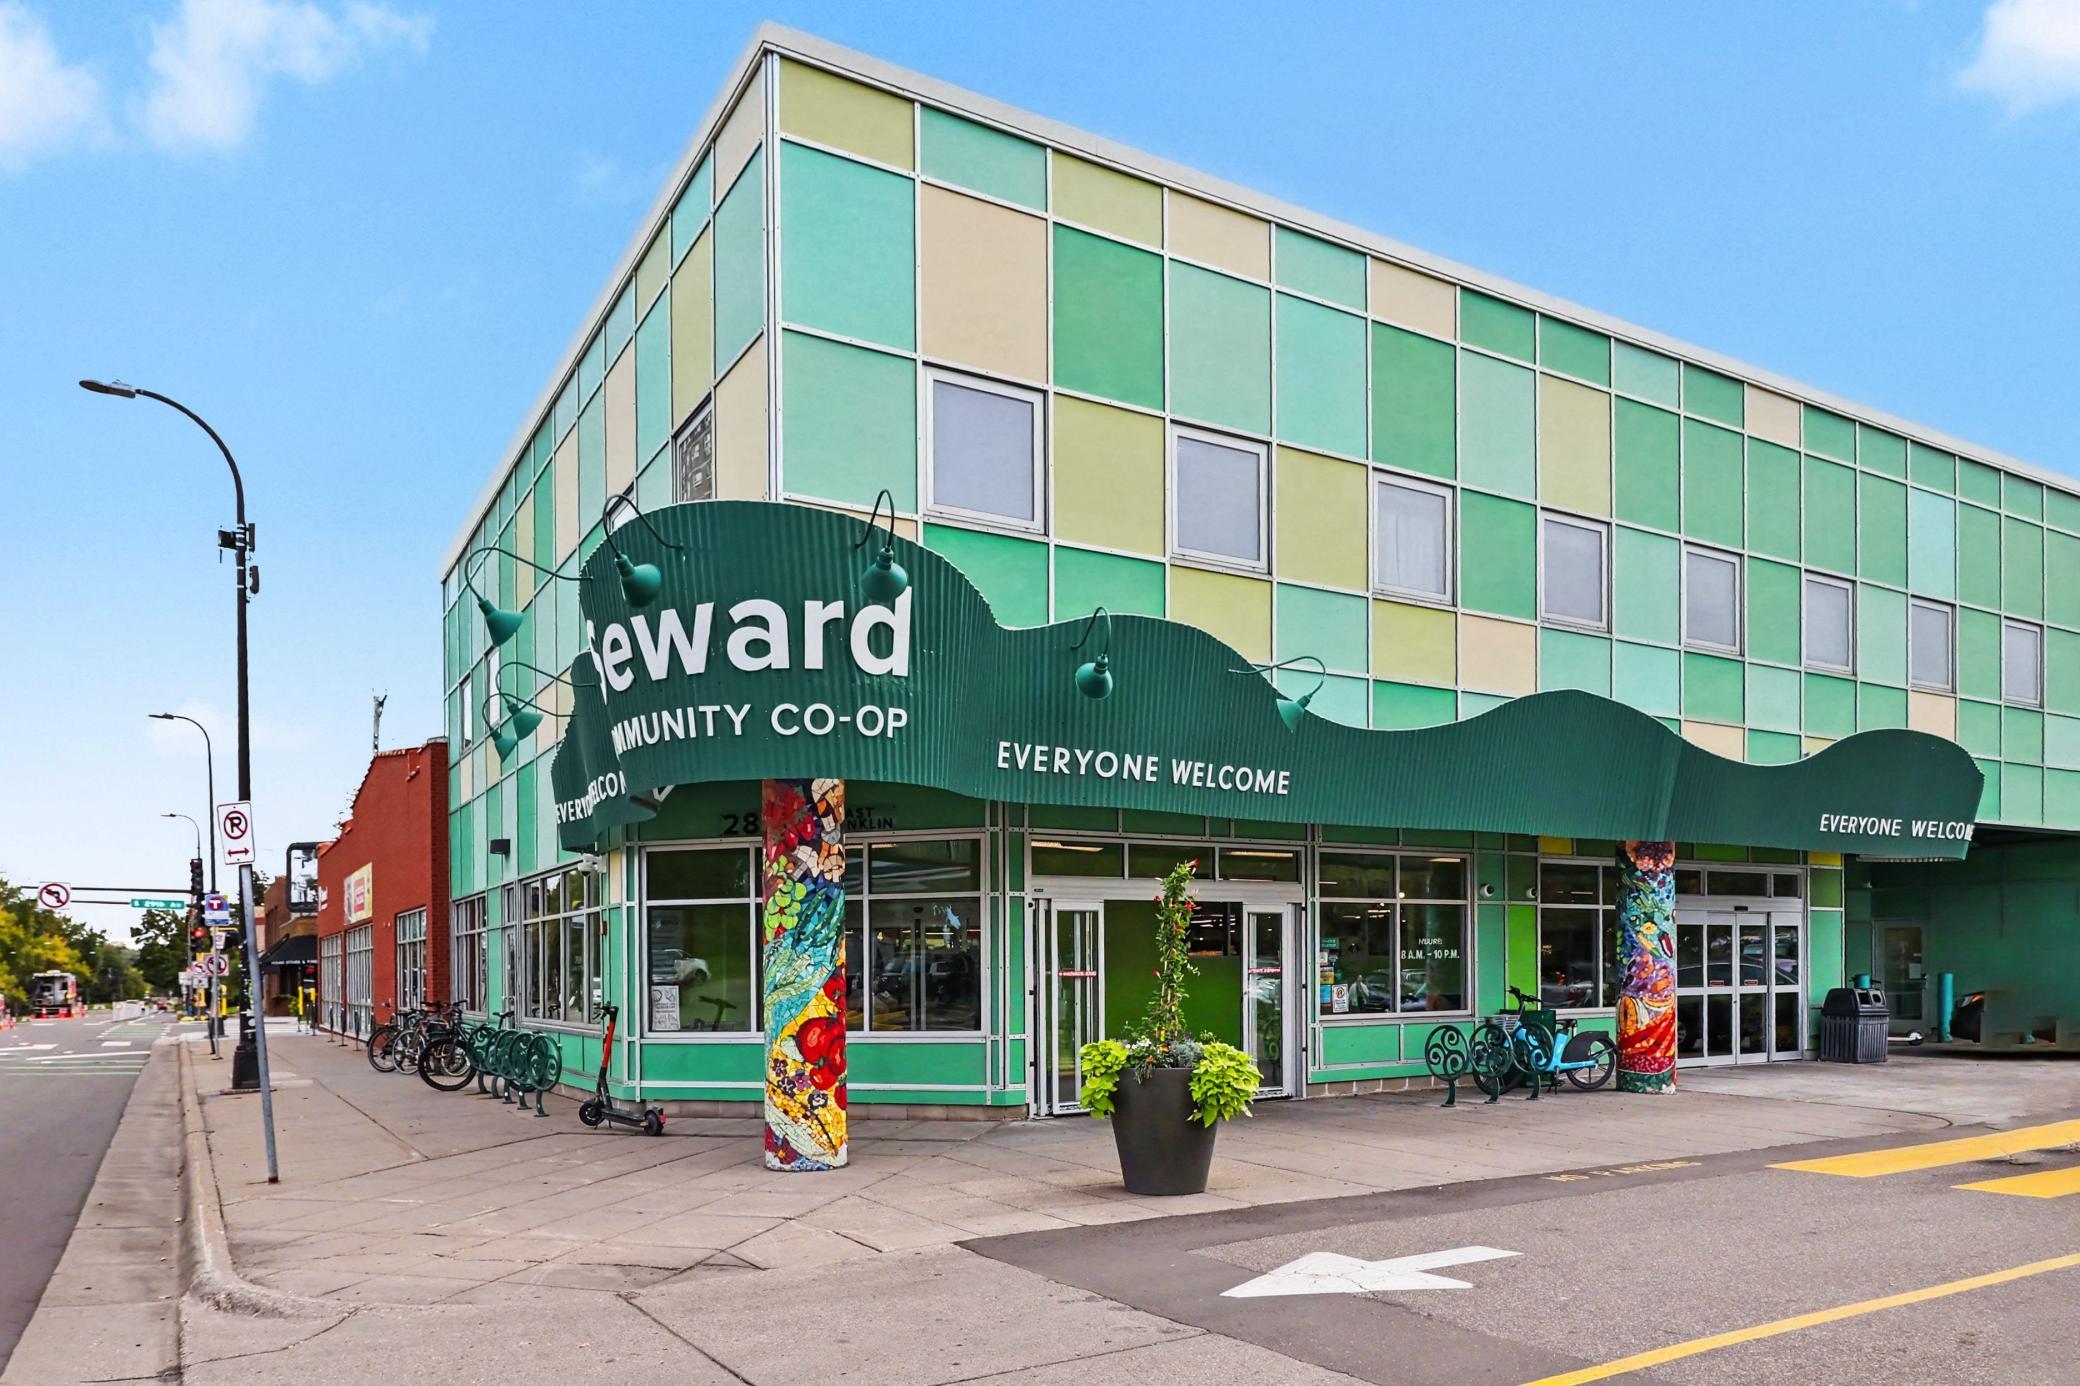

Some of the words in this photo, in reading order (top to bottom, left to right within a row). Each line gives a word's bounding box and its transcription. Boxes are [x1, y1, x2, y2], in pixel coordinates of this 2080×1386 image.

[611, 703, 752, 759] MMUNITY
[771, 703, 908, 738] CO-OP
[997, 741, 1159, 782] EVERYONE
[1171, 758, 1291, 795] WELCOME
[722, 812, 761, 836] 28
[845, 806, 875, 819] AST
[847, 817, 894, 831] NKLIN
[1819, 813, 1903, 836] EVERYONE
[1911, 820, 1975, 841] WELCOM
[1400, 949, 1407, 960] 8
[1433, 949, 1443, 960] 10
[1444, 949, 1460, 959] P.M.
